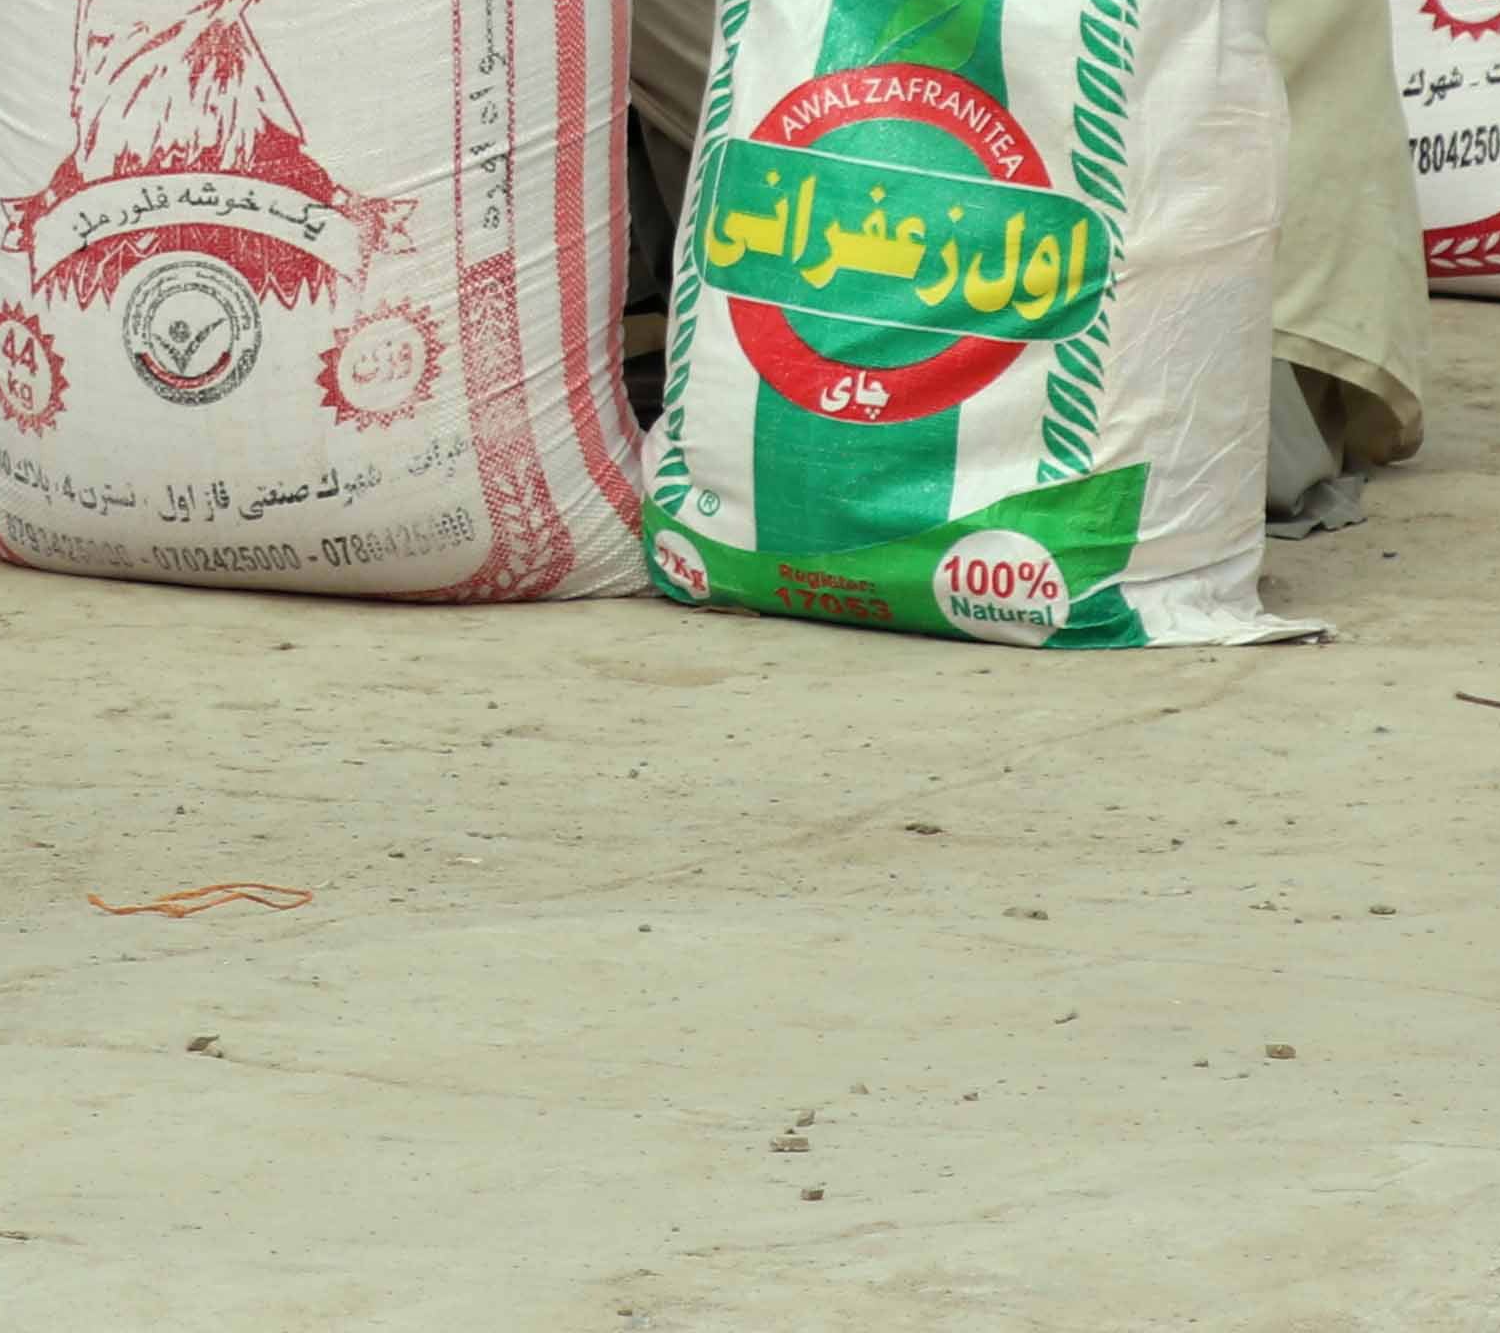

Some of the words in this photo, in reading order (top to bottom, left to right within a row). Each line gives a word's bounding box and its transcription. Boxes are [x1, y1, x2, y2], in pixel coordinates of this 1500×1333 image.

[779, 86, 859, 143] AWAL
[860, 75, 995, 136] ZAFRANI
[984, 122, 1026, 181] TEA
[114, 183, 171, 228] فلور
[177, 182, 261, 216] خوشه
[267, 197, 336, 244] یک
[706, 167, 964, 305] زعفرانی
[963, 210, 1089, 321] اول
[0, 334, 39, 376] 44
[4, 370, 36, 411] kg
[819, 364, 890, 420] چای
[157, 482, 198, 523] اول
[203, 479, 232, 524] فاز
[237, 480, 311, 522] صنعتی
[152, 542, 303, 574] 0702425000
[942, 554, 1060, 601] 100%
[949, 595, 1054, 629] Natural
